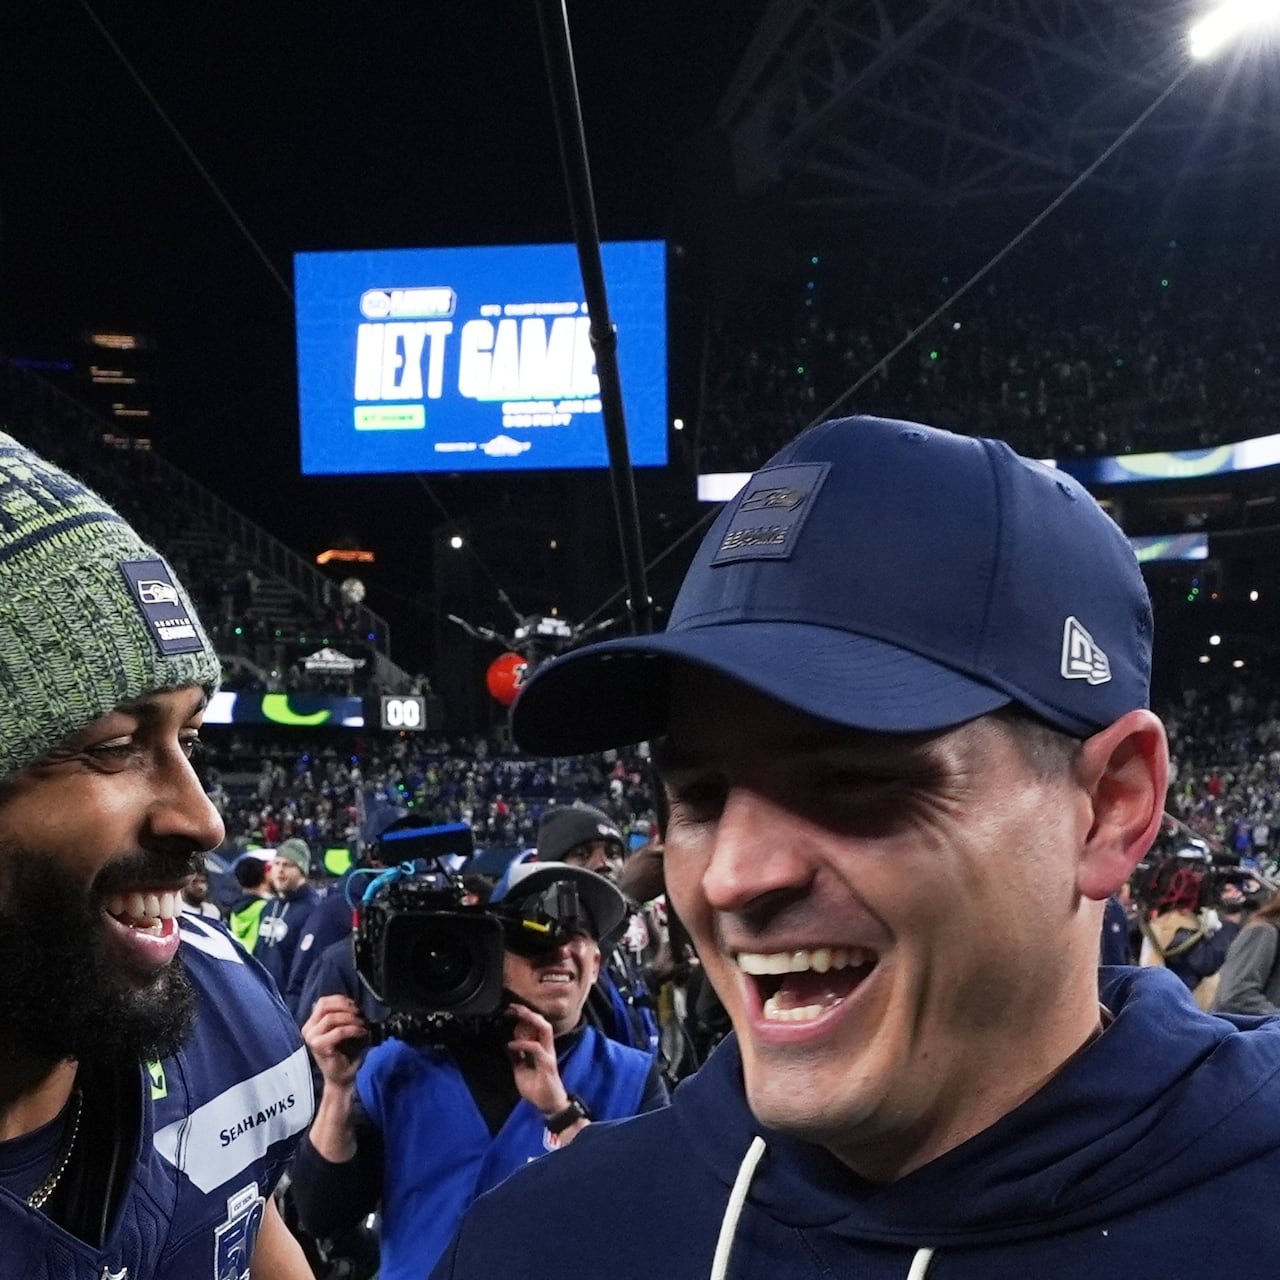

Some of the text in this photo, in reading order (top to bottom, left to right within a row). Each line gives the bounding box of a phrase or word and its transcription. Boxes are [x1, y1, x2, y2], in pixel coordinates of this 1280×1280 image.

[354, 316, 602, 402] NEXT GAME
[386, 700, 420, 727] 00
[220, 1094, 296, 1148] SEAHAWKS
